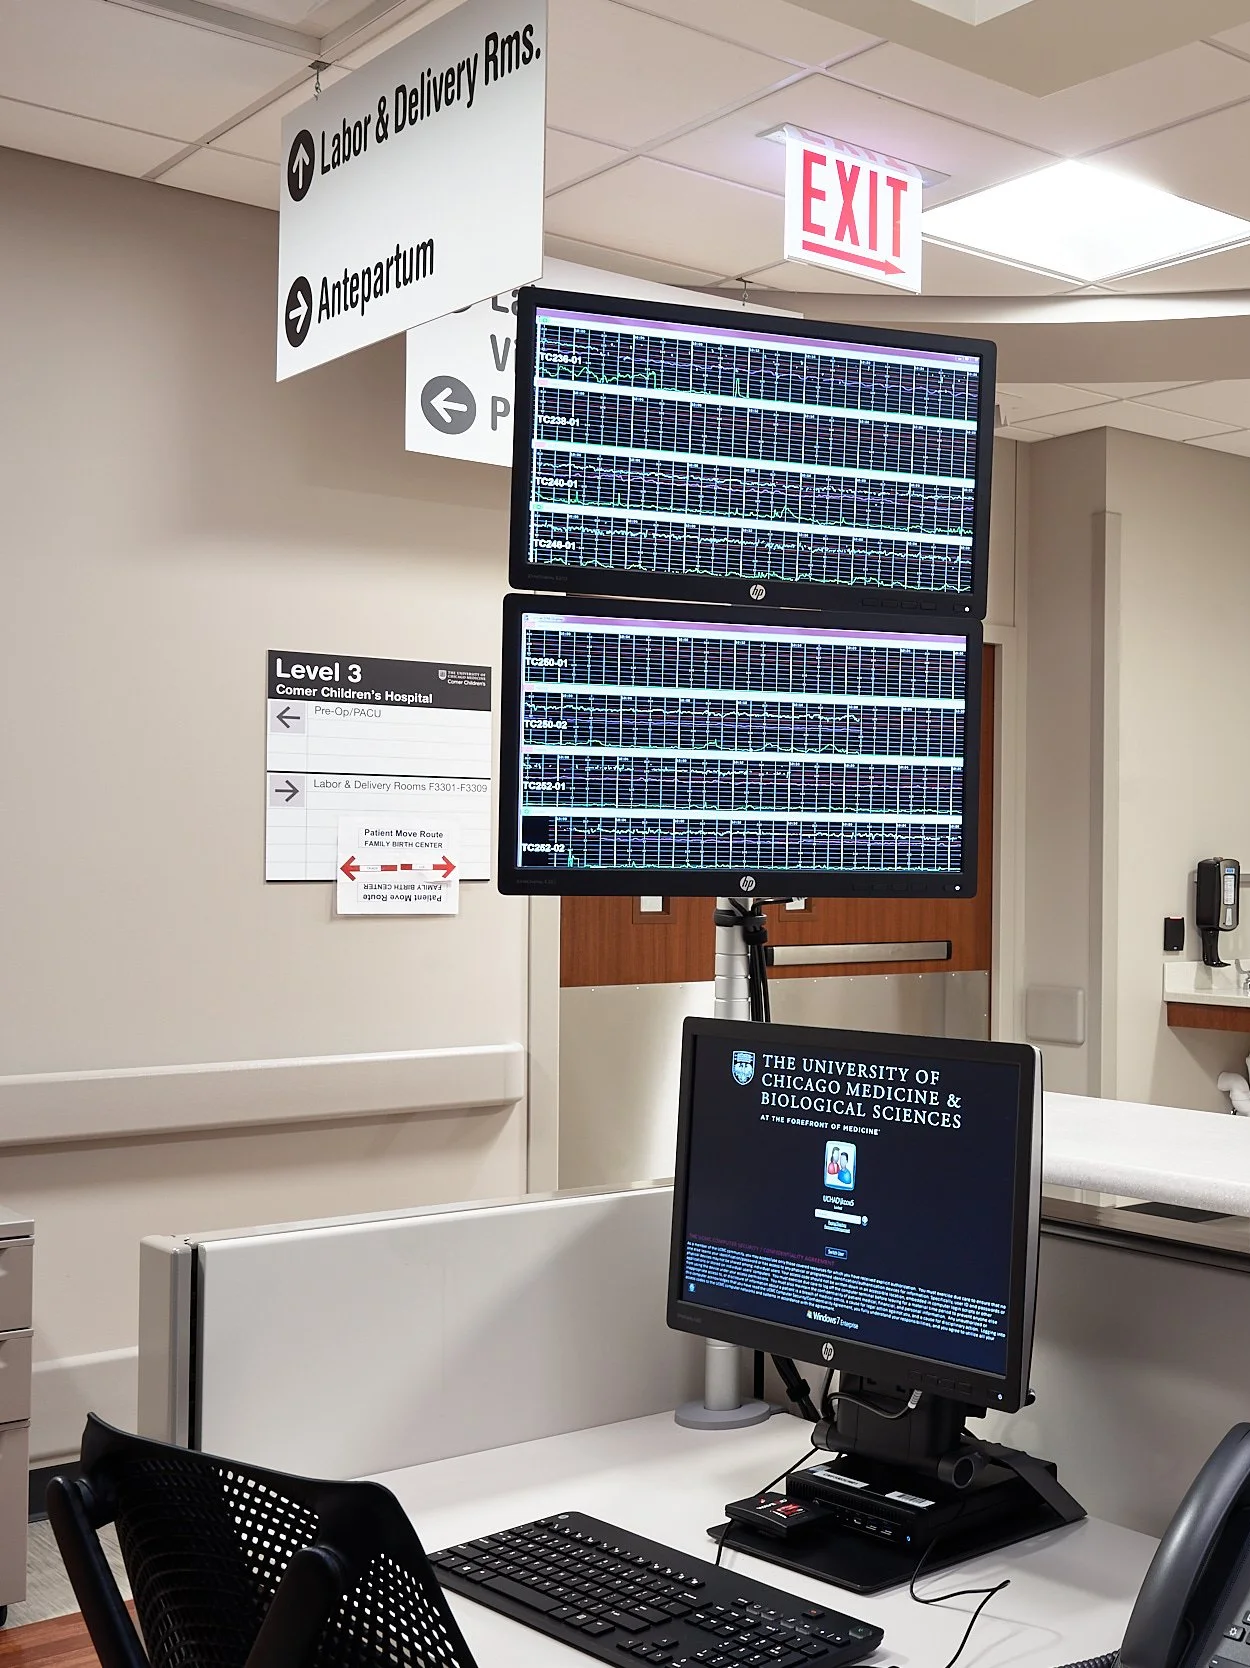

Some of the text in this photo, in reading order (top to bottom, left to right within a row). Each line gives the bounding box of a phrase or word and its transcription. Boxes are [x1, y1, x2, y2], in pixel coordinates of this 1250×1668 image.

[321, 23, 541, 175] Labor & Delivery Rms.
[802, 149, 908, 258] EXIT
[317, 238, 434, 324] Antepartum
[491, 395, 511, 432] P
[750, 584, 766, 600] hp
[276, 657, 362, 683] Level 3
[276, 684, 433, 705] Comer Children's Hospital
[314, 706, 382, 718] Pre-Op/PACU
[313, 779, 488, 793] Labor & Delivery Rooms F3301-F3309
[364, 829, 444, 839] Patient Move Route
[415, 841, 443, 849] CENTER
[740, 875, 756, 892] hp
[362, 894, 442, 902] Patient Move Route
[762, 1053, 940, 1086] THE UNIVERSITY OF
[761, 1073, 962, 1109] CHICAGO MEDICINE &
[760, 1091, 962, 1129] BIOLOGICAL SCIENCES
[760, 1114, 770, 1122] AT
[771, 1115, 785, 1123] THE
[787, 1117, 829, 1129] FOREFRONT
[831, 1122, 841, 1130] OF
[813, 1311, 837, 1325] Windows
